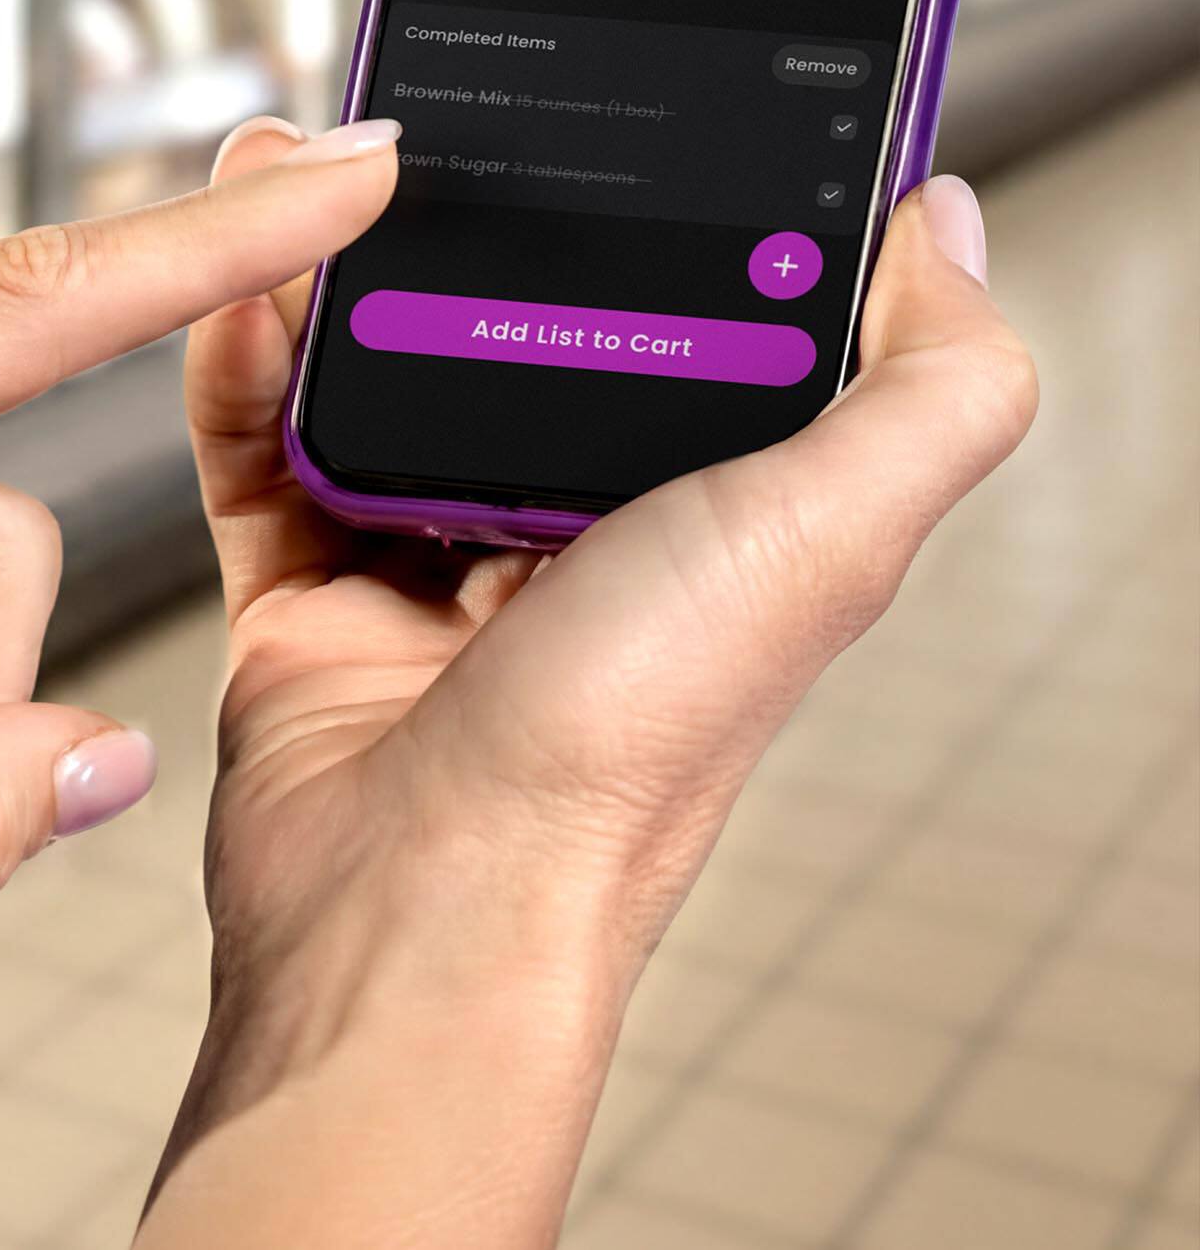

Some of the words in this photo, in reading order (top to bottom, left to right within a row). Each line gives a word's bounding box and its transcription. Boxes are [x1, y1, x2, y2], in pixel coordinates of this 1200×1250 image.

[405, 26, 504, 46] Completed
[507, 34, 556, 50] Items
[785, 57, 858, 75] Remove
[394, 82, 474, 103] Brownie
[478, 89, 512, 106] Mix
[515, 94, 533, 108] 15
[537, 98, 601, 113] ounces
[606, 99, 622, 117] (1
[625, 101, 665, 121] box)
[448, 155, 508, 177] Sugar
[513, 161, 524, 175] 3
[527, 162, 637, 184] tablespoons
[471, 319, 529, 342] Add
[536, 324, 585, 348] List
[594, 330, 621, 350] to
[630, 333, 693, 358] Cart
